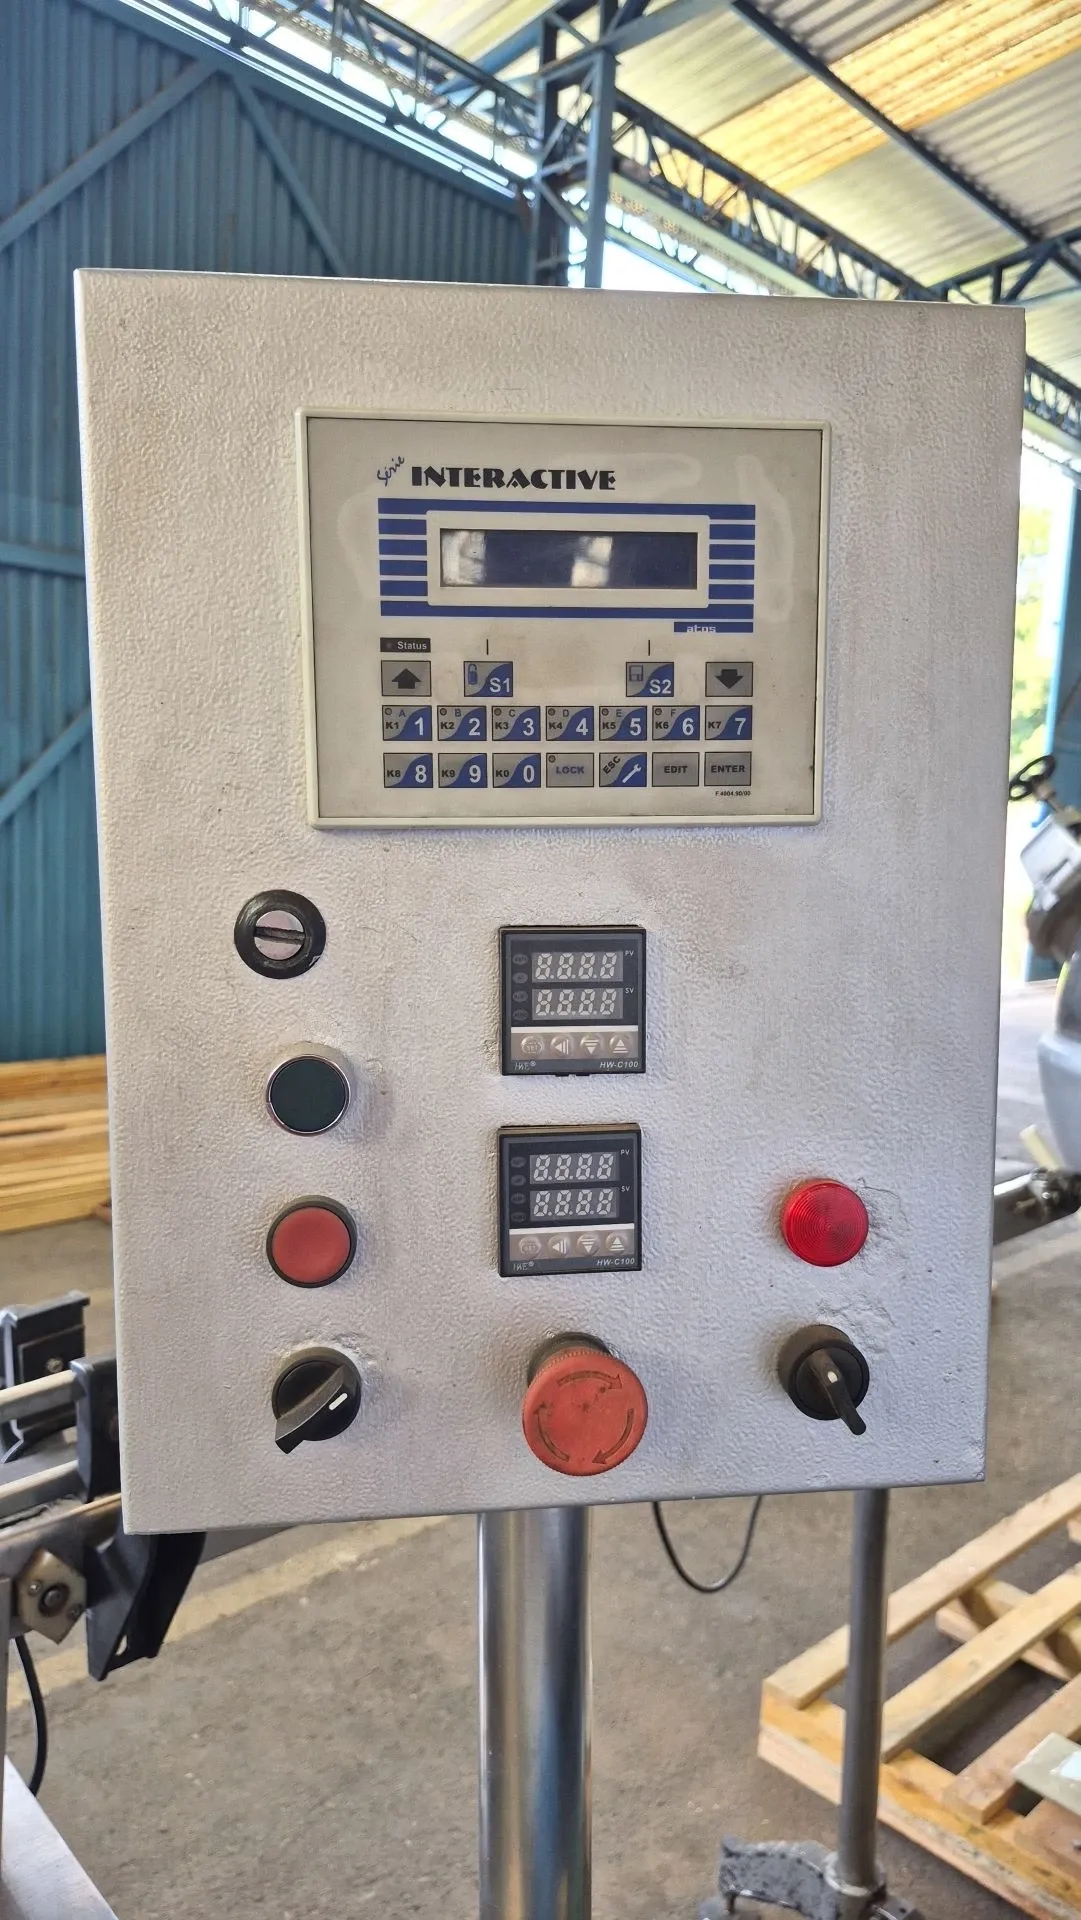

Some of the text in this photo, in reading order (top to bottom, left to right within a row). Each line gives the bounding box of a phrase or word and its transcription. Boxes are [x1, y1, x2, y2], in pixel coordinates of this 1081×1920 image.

[411, 466, 616, 490] INTERACTIVE
[397, 641, 427, 650] Status
[489, 677, 510, 693] S1
[650, 679, 672, 694] S2
[398, 709, 406, 717] A
[455, 709, 462, 717] B
[508, 709, 516, 717] C
[563, 709, 570, 717] D
[616, 709, 622, 717] E
[670, 709, 676, 717] F
[386, 722, 399, 730] K1
[414, 717, 424, 736] 1
[441, 722, 455, 730] K2
[468, 717, 481, 736] 2
[495, 722, 509, 730] K3
[523, 717, 535, 736] 3
[549, 722, 562, 730] K4
[576, 717, 588, 736] 4
[602, 722, 616, 730] K5
[629, 717, 641, 736] 5
[655, 721, 669, 729] K6
[682, 717, 694, 736] 6
[708, 721, 721, 729] K7
[734, 717, 747, 735] 7
[602, 755, 621, 775] ESC
[711, 765, 745, 773] ENTER
[387, 769, 400, 777] K8
[415, 764, 427, 783] 8
[441, 769, 456, 777] K9
[469, 764, 481, 783] 9
[495, 769, 509, 777] K0
[523, 764, 535, 783] 0
[556, 766, 585, 775] LOCK
[664, 765, 688, 774] EDIT
[600, 1061, 639, 1069] HW-C100
[597, 1258, 635, 1266] HW-C100
